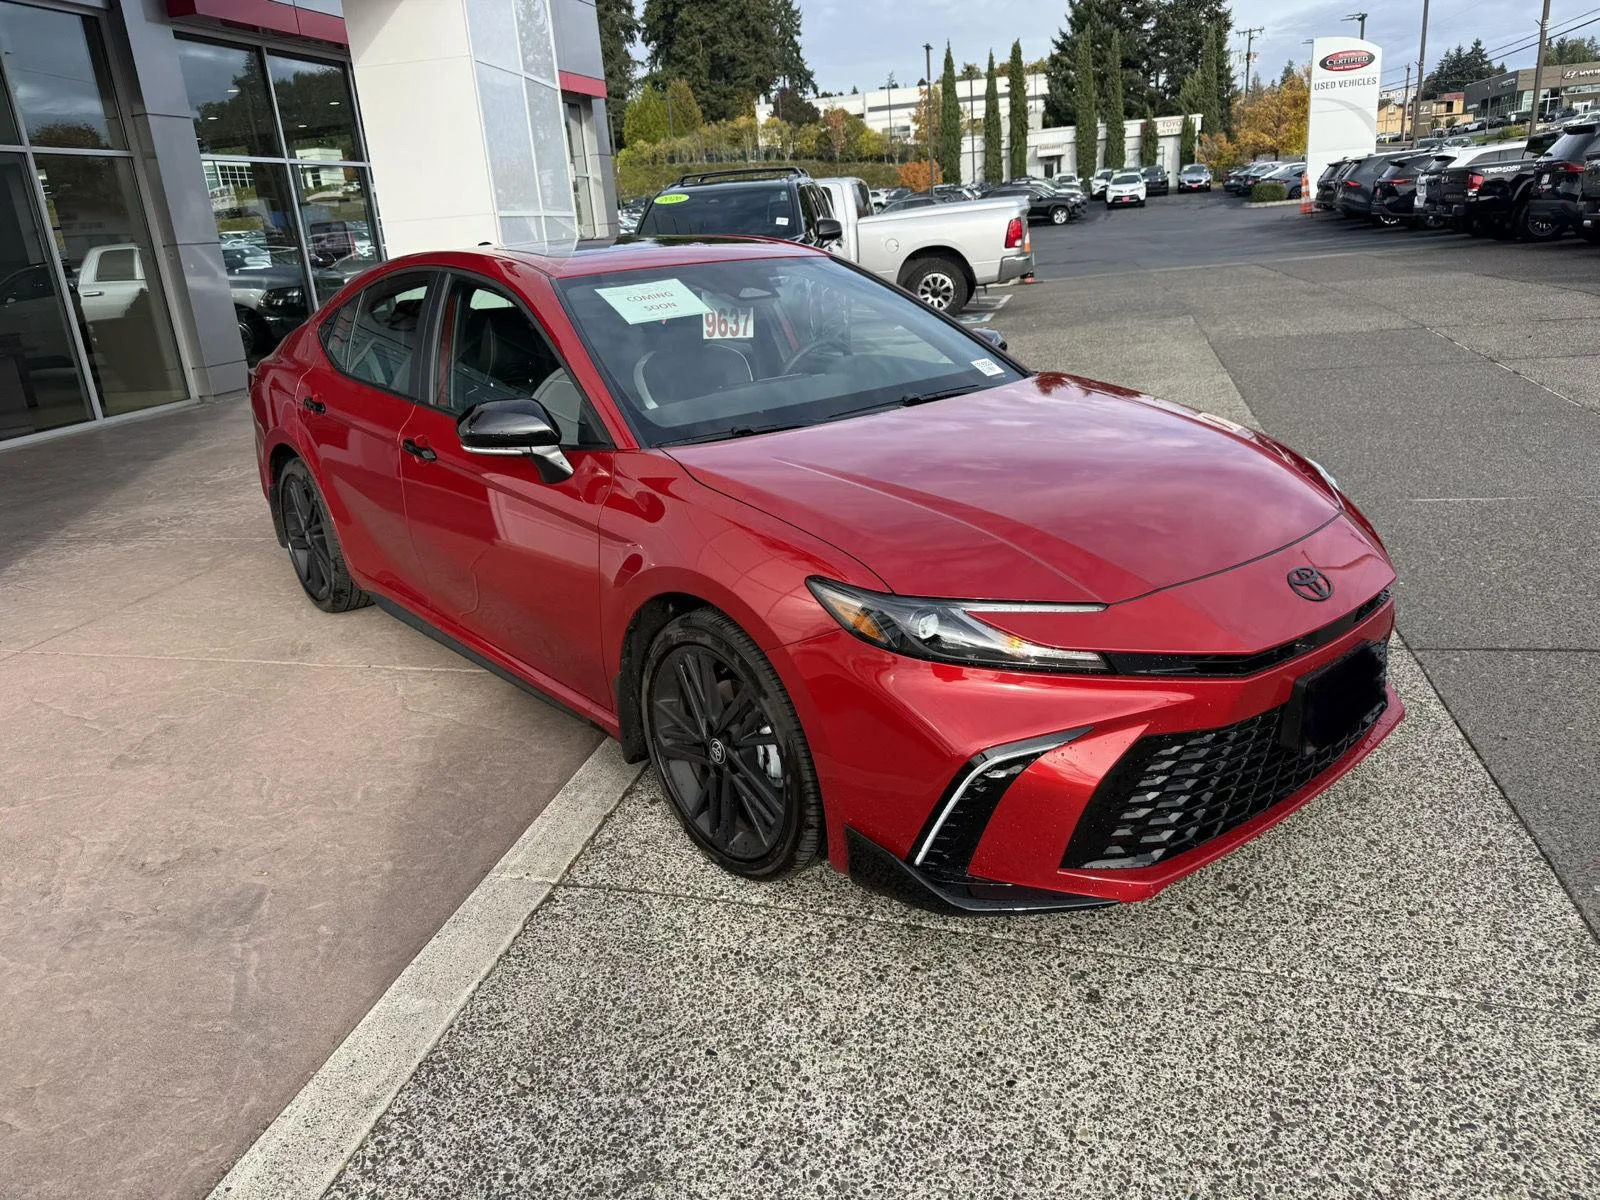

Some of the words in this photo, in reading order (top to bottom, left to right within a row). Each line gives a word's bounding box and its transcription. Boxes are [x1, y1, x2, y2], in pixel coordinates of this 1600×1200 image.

[1326, 56, 1369, 66] CERTIFIED
[1314, 81, 1336, 90] USED
[1338, 77, 1377, 88] VEHICLES
[626, 291, 674, 303] COMING
[643, 302, 678, 312] SOON
[705, 308, 750, 337] 9637
